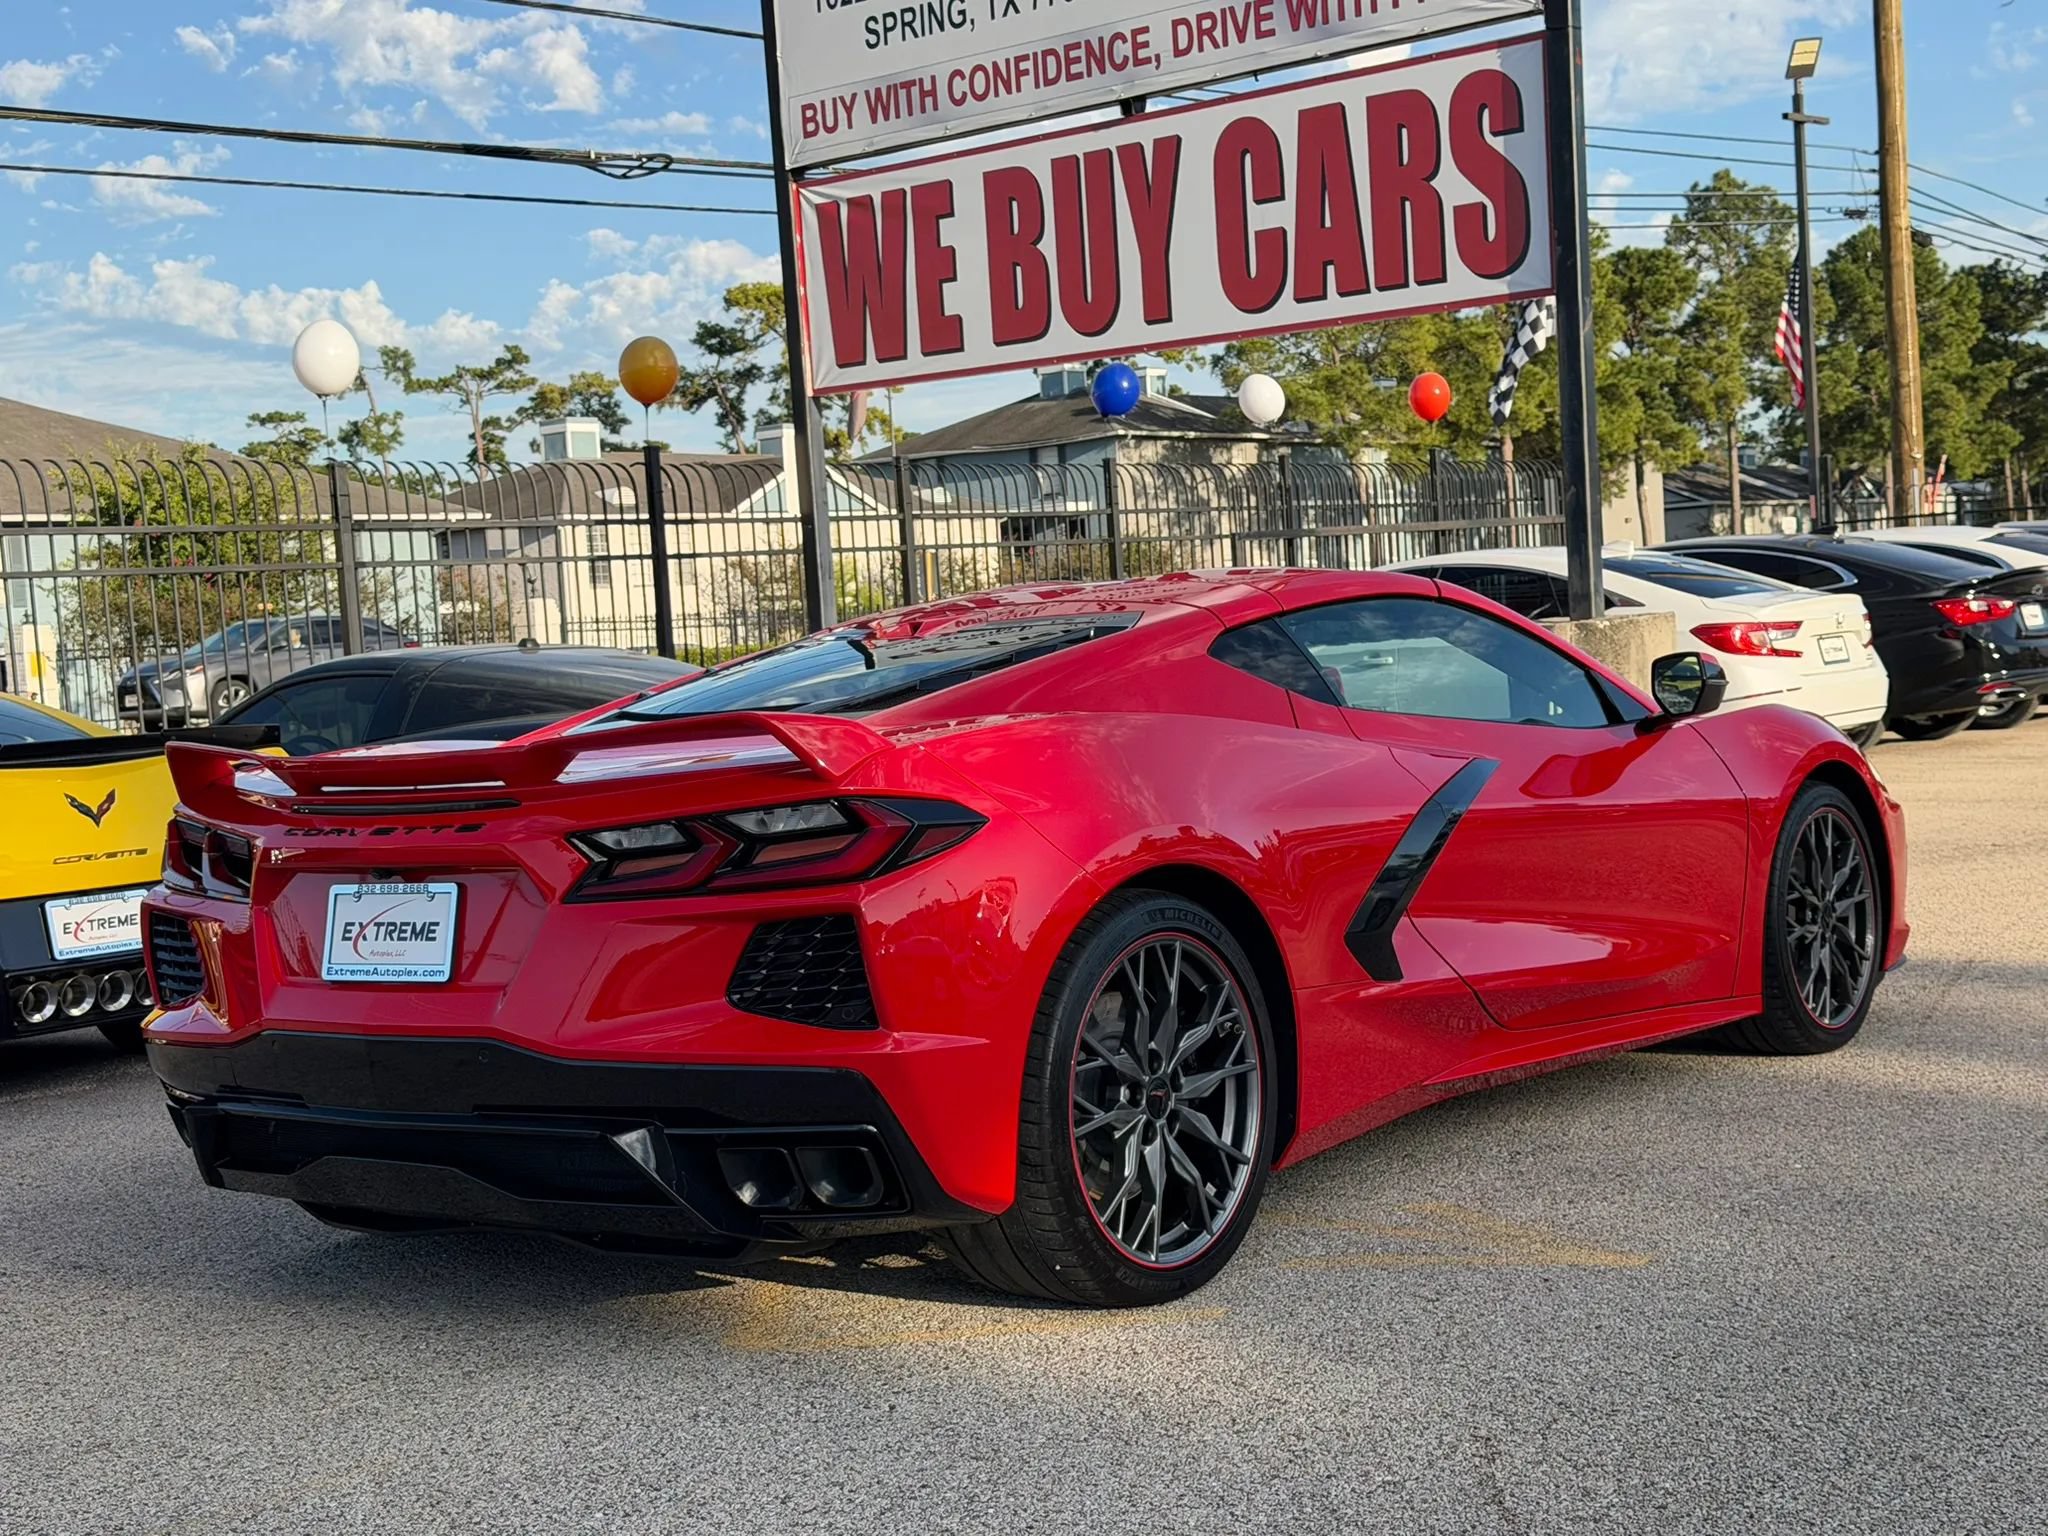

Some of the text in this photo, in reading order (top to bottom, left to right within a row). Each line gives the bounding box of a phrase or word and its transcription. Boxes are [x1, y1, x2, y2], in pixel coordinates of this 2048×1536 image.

[864, 0, 975, 49] SPRING,
[801, 92, 858, 139] BUY
[864, 74, 939, 125] WITH
[947, 25, 1161, 107] CONFIDENCE,
[1171, 0, 1276, 58] DRIVE
[816, 68, 1530, 367] WE BUY CARS
[284, 823, 487, 836] CORVETTE
[53, 847, 148, 865] CORVETTE
[63, 913, 139, 935] EXTREME
[341, 921, 441, 942] EXTREME
[326, 966, 445, 979] ExtremeAutoplex.com
